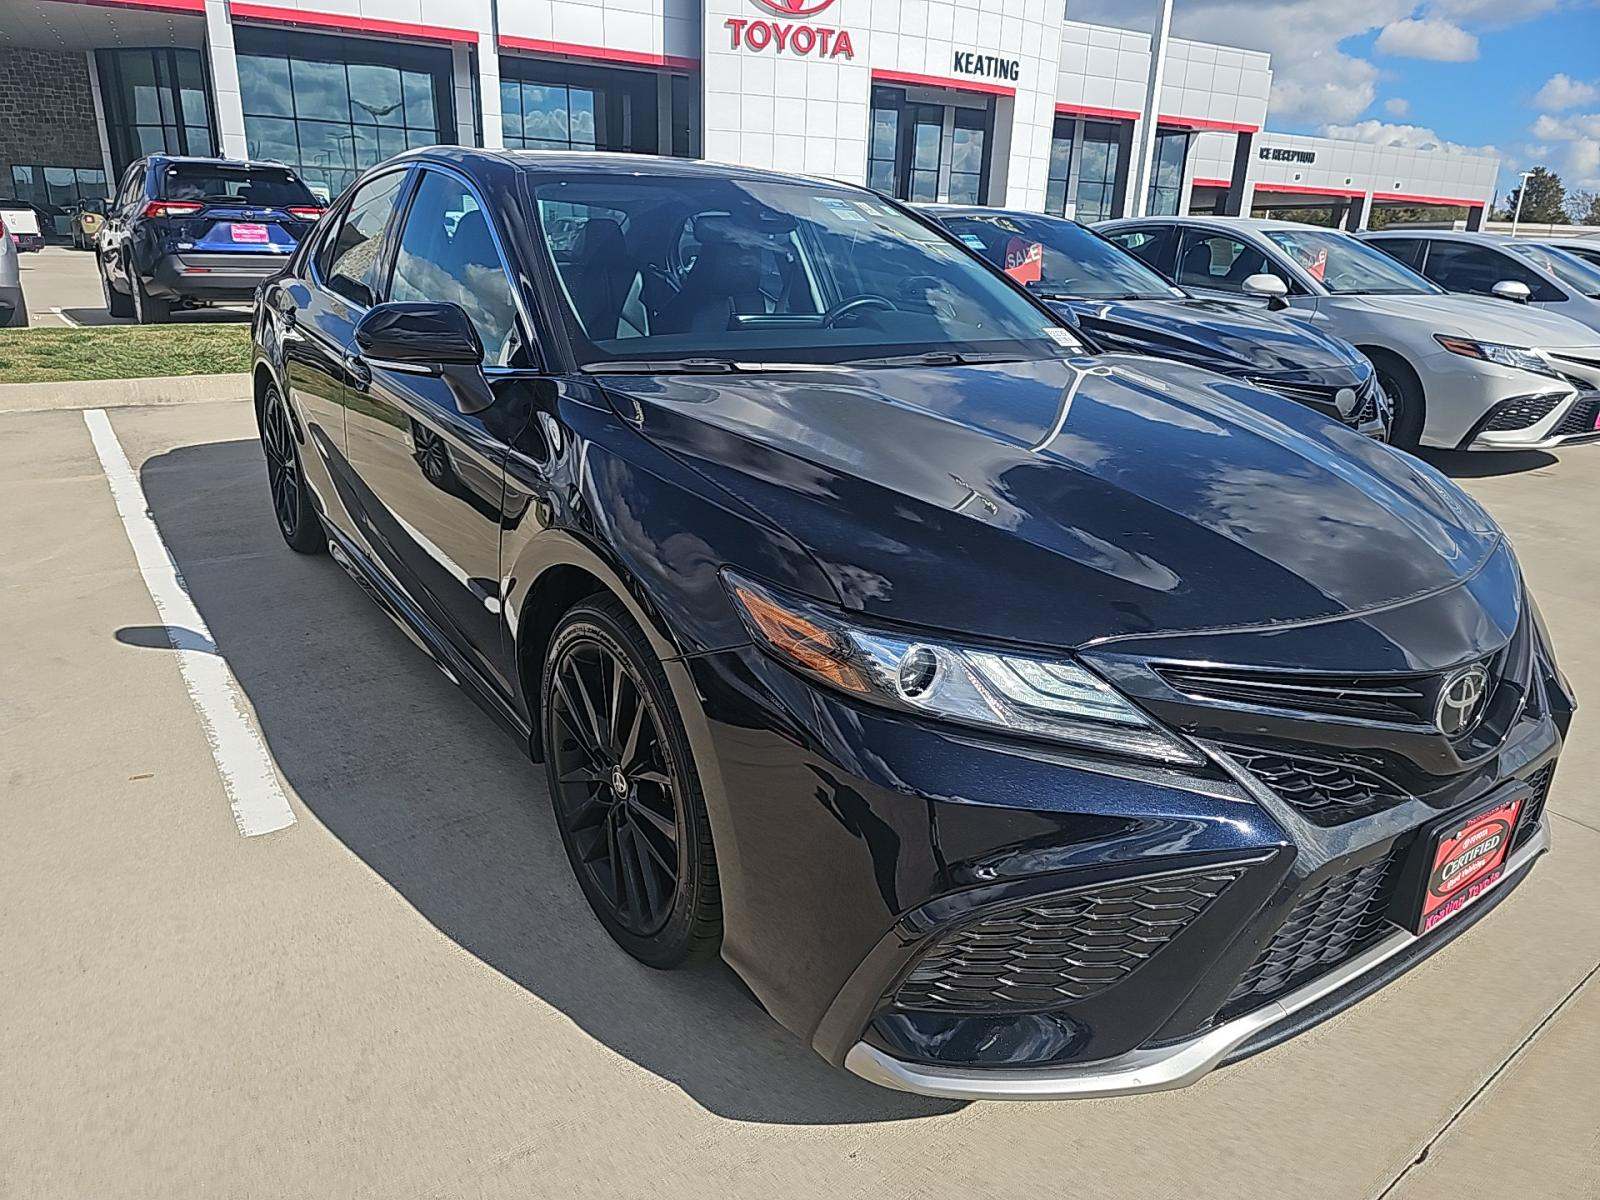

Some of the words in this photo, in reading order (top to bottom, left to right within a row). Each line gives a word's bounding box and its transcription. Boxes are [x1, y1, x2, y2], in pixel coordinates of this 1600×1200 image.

[726, 18, 854, 60] TOYOTA
[953, 51, 1019, 81] KEATING
[1007, 243, 1040, 268] SALE
[1442, 835, 1500, 880] CERTIFIED
